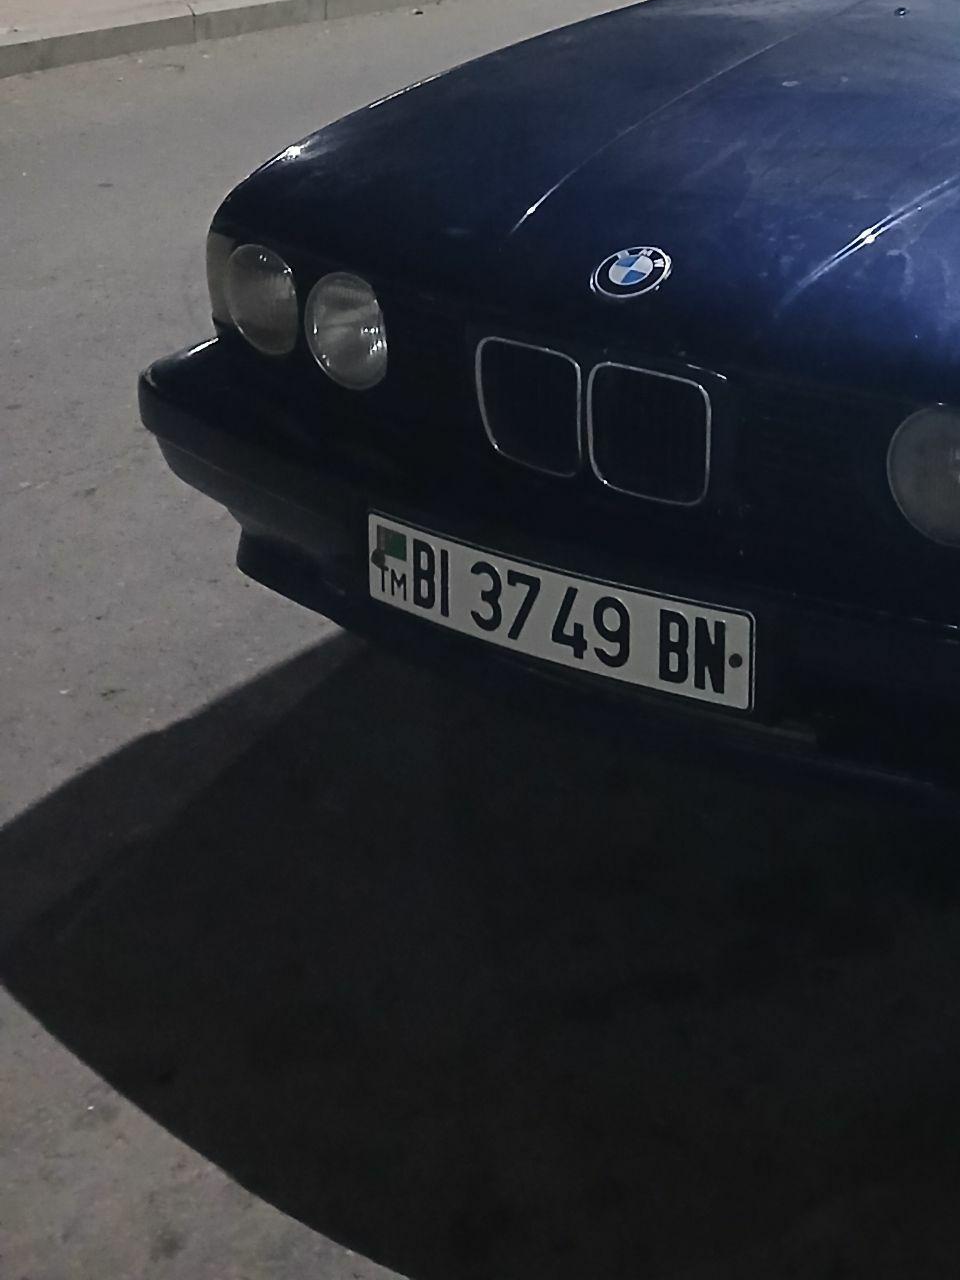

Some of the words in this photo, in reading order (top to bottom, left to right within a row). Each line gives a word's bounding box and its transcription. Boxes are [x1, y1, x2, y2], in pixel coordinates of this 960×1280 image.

[379, 564, 407, 602] TM
[412, 538, 449, 618] BI
[659, 608, 726, 694] BN
